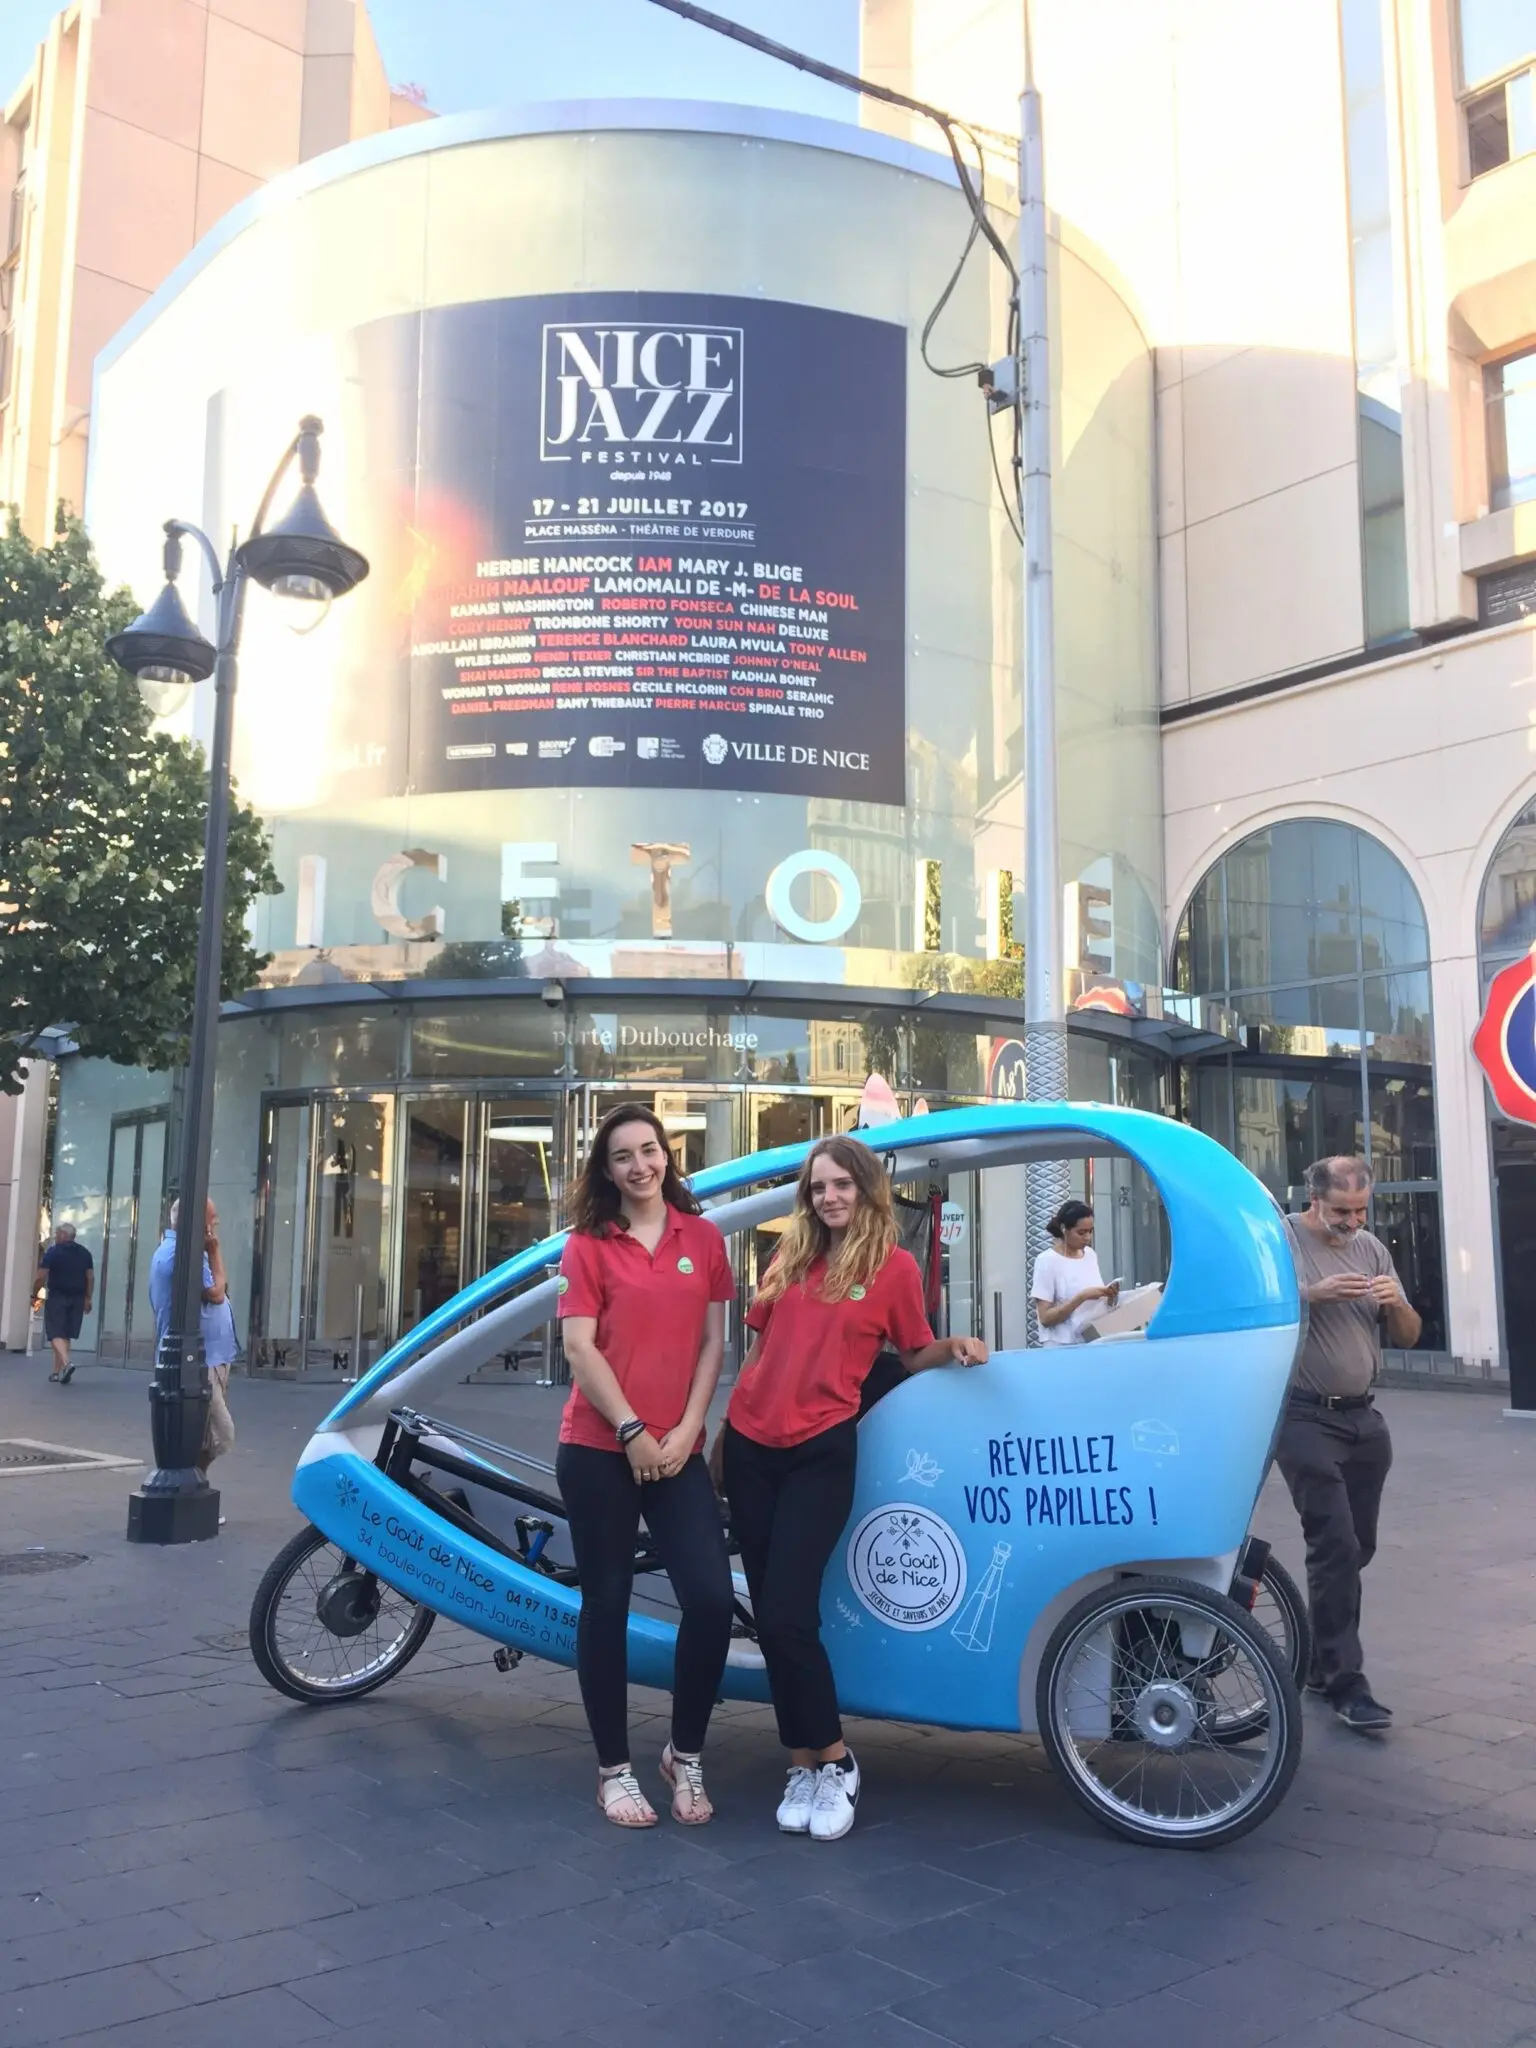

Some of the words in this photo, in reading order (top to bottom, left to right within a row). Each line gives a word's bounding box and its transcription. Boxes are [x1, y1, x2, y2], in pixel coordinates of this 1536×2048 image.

[555, 330, 734, 392] NICE
[547, 375, 734, 446] JAZZ
[581, 451, 702, 466] FESTIVAL
[610, 470, 646, 483] depuis
[532, 499, 554, 517] 17
[578, 498, 600, 515] 21
[606, 499, 693, 516] JUILLET
[699, 501, 749, 519] 2017
[525, 525, 561, 538] PLACE
[564, 521, 618, 536] MASSÉNA
[629, 521, 681, 538] THÉÂTRE
[683, 526, 700, 539] DE
[702, 526, 755, 541] VERDURE
[476, 557, 541, 578] HERBIE
[543, 555, 633, 574] HANCOCK
[638, 556, 673, 573] IAM
[678, 557, 730, 576] MARY
[734, 561, 749, 578] J.
[753, 562, 803, 583] BLIGE
[503, 576, 591, 597] MAALOUF
[594, 576, 691, 595] LAMOMALI
[695, 579, 721, 596] DE
[724, 581, 755, 598] -M-
[759, 583, 781, 601] DE
[789, 586, 811, 604] LA
[815, 590, 859, 611] SOUL
[450, 601, 500, 619] KAMASI
[502, 597, 594, 615] WASHINGTON
[602, 597, 667, 612] ROBERTO
[670, 599, 735, 615] FONSECA
[740, 602, 796, 620] CHINESE
[798, 608, 828, 625] MAN
[449, 619, 485, 636] CORY
[487, 617, 531, 633] HENRY
[533, 614, 611, 630] TROMBONE
[613, 614, 668, 629] SHORTY
[674, 616, 713, 631] YOUN
[716, 618, 744, 632] SUN
[747, 620, 776, 635] NAH
[778, 623, 830, 641] DELUXE
[538, 632, 601, 648] TERENCE
[603, 632, 688, 648] BLANCHARD
[691, 635, 737, 650] LAURA
[740, 638, 786, 654] MVULA
[789, 641, 825, 658] TONY
[827, 646, 867, 663] ALLEN
[614, 650, 677, 664] CHRISTIAN
[678, 652, 730, 666] MCBRIDE
[733, 654, 779, 669] JOHNNY
[781, 658, 822, 673] O'NEAL
[488, 667, 541, 681] MAESTRO
[542, 666, 582, 679] BECCA
[583, 666, 634, 678] STEVENS
[636, 665, 655, 678] SIR
[656, 666, 679, 679] THE
[682, 667, 729, 681] BAPTIST
[731, 670, 777, 685] KADHJA
[780, 674, 817, 688] BONET
[487, 684, 503, 697] TO
[504, 682, 551, 696] WOMAN
[633, 682, 673, 694] CECILE
[675, 683, 728, 697] MCLORIN
[730, 685, 754, 698] CON
[756, 687, 784, 700] BRIO
[786, 690, 834, 706] SERAMIC
[591, 697, 654, 710] THIEBAULT
[655, 698, 697, 711] PIERRE
[699, 699, 747, 713] MARCUS
[748, 703, 796, 717] SPIRALE
[798, 706, 825, 720] TRIO
[730, 741, 786, 763] VILLE
[791, 746, 818, 766] DE
[822, 749, 870, 772] NICE
[243, 842, 1112, 974] ICETOILE
[621, 1025, 759, 1051] Dubouchage
[941, 1213, 965, 1222] UVERT
[988, 1431, 1118, 1478] RÉVEILLEZ
[964, 1485, 1011, 1525] VOS
[1025, 1486, 1134, 1526] PAPILLES
[1149, 1486, 1159, 1526] !
[361, 1501, 382, 1526] Le
[385, 1515, 425, 1552] Goût
[429, 1544, 452, 1568] de
[455, 1557, 496, 1593] Nice
[875, 1551, 896, 1567] Le
[899, 1552, 940, 1570] Goût
[357, 1527, 373, 1548] 34
[377, 1542, 446, 1595] boulevard
[448, 1585, 537, 1638] Jean-Jaurès
[540, 1624, 552, 1643] à
[555, 1630, 577, 1653] Nic
[875, 1569, 899, 1584] de
[902, 1570, 940, 1588] Nice
[506, 1589, 522, 1608] 04
[525, 1597, 540, 1613] 97
[543, 1604, 558, 1621] 13
[561, 1612, 578, 1629] 55
[868, 1591, 892, 1614] SECRETS
[892, 1607, 900, 1617] ET
[902, 1608, 929, 1621] SAVEURS
[928, 1605, 938, 1616] DU
[937, 1592, 951, 1611] PAYS
